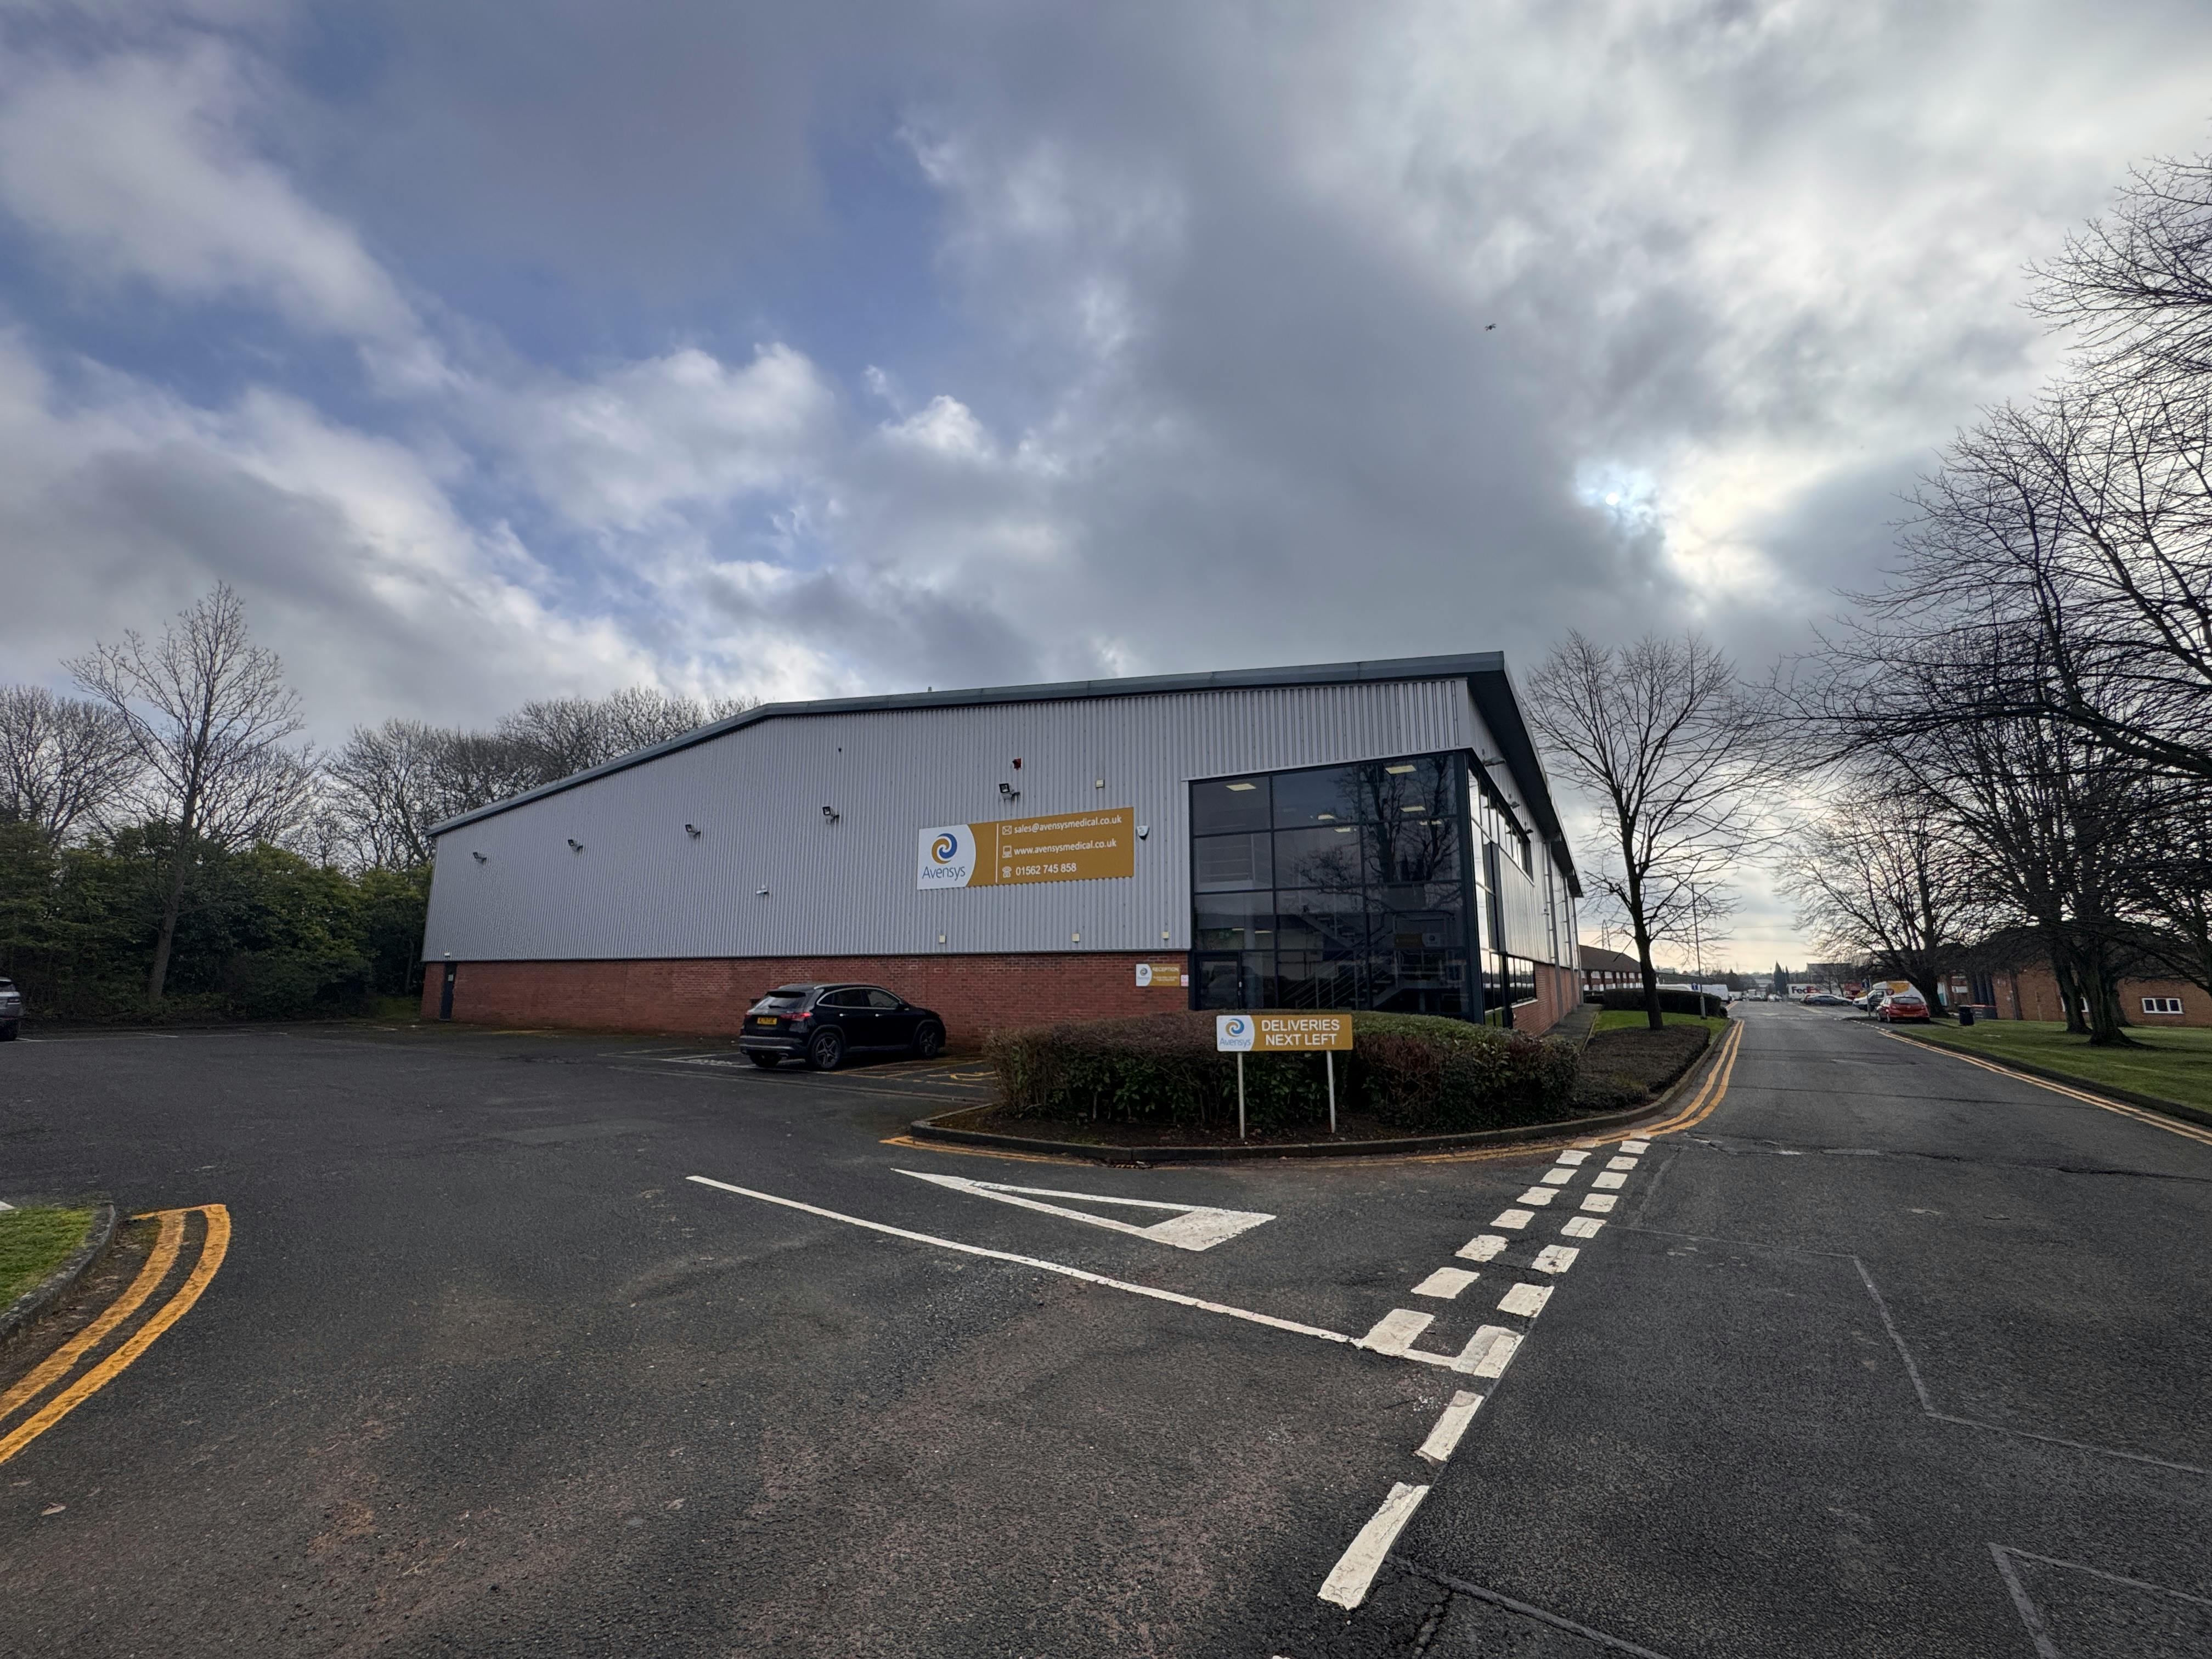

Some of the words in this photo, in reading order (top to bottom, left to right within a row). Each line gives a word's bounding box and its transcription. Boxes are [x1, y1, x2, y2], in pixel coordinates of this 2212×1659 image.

[1014, 815, 1122, 833] sales@avensysmedical.co.uk
[1014, 838, 1117, 855] www.avensysmedical.co.uk
[922, 866, 966, 882] Avensys
[1015, 865, 1041, 876] 01562
[1043, 864, 1059, 874] 745
[1060, 862, 1077, 873] 858
[1791, 986, 1821, 994] FedEx
[1261, 1019, 1340, 1032] DELIVERIES
[1219, 1037, 1251, 1048] Avensys
[1265, 1034, 1301, 1046] NEXT
[1305, 1034, 1338, 1045] LEFT
